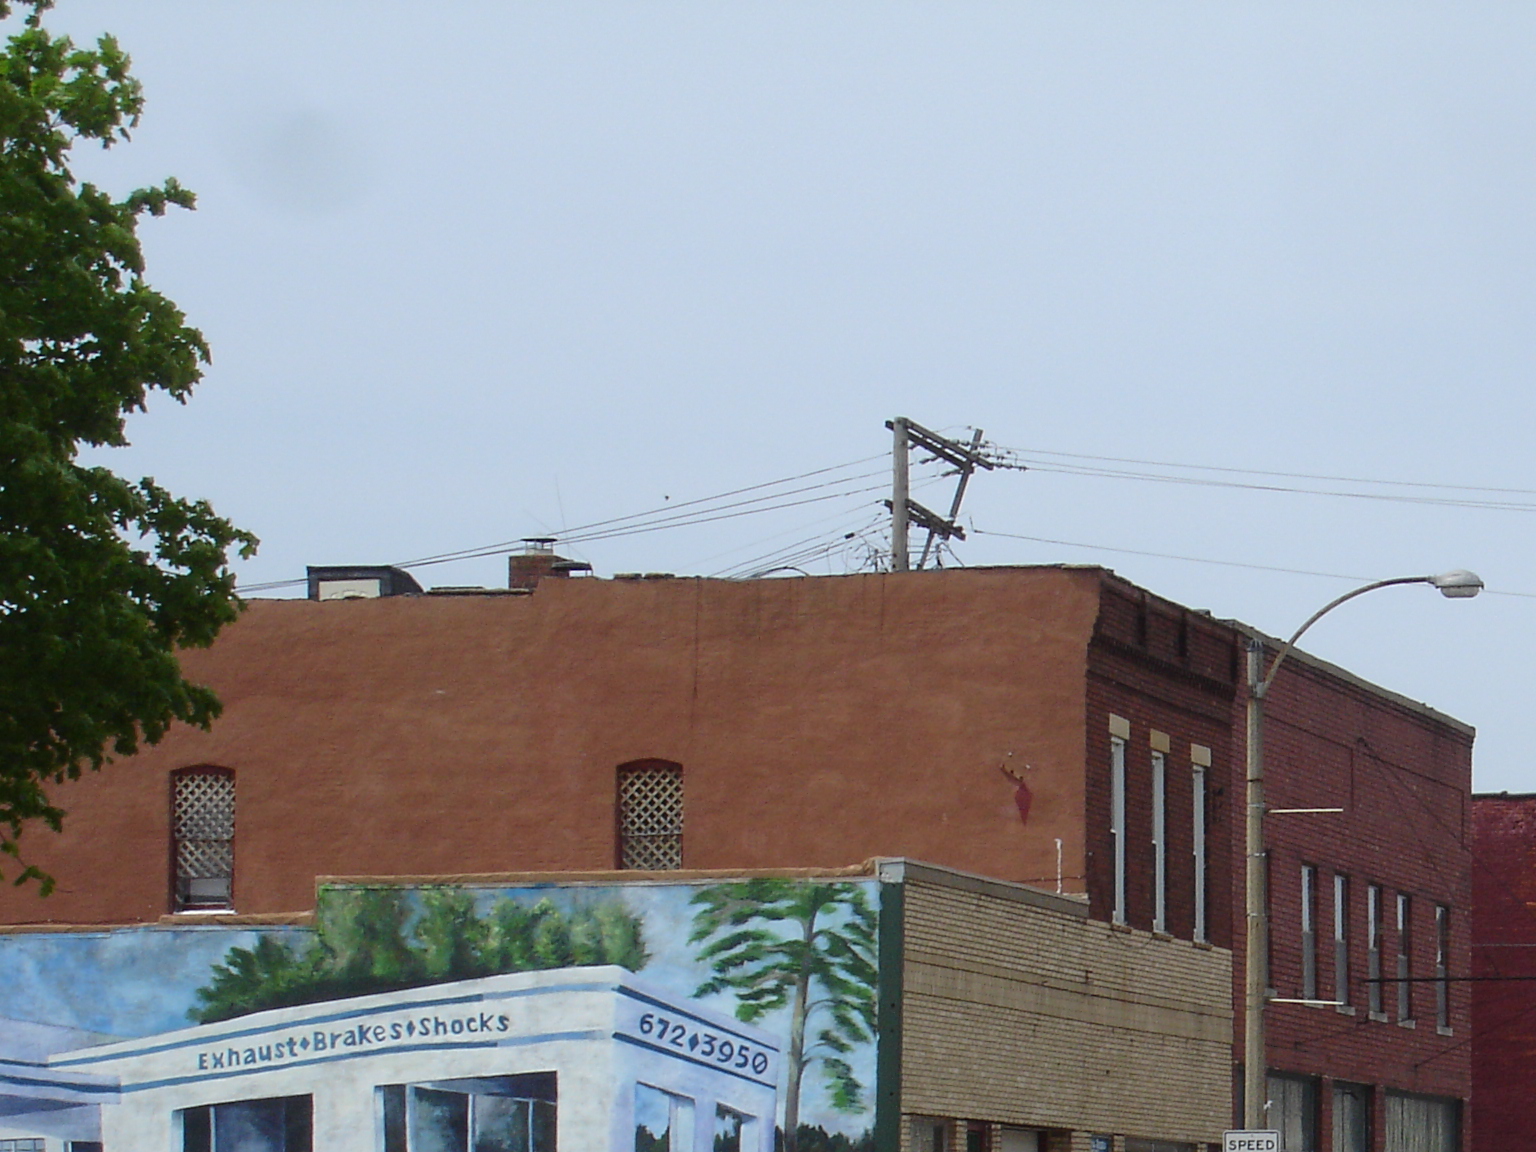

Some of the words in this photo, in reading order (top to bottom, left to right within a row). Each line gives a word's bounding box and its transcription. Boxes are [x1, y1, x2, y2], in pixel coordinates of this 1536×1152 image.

[198, 1036, 298, 1071] Exhaust
[313, 1023, 402, 1052] Brakes
[419, 1012, 510, 1037] Shocks
[639, 1013, 687, 1048] 672
[701, 1033, 769, 1075] 3950
[1228, 1140, 1275, 1151] SPEED
